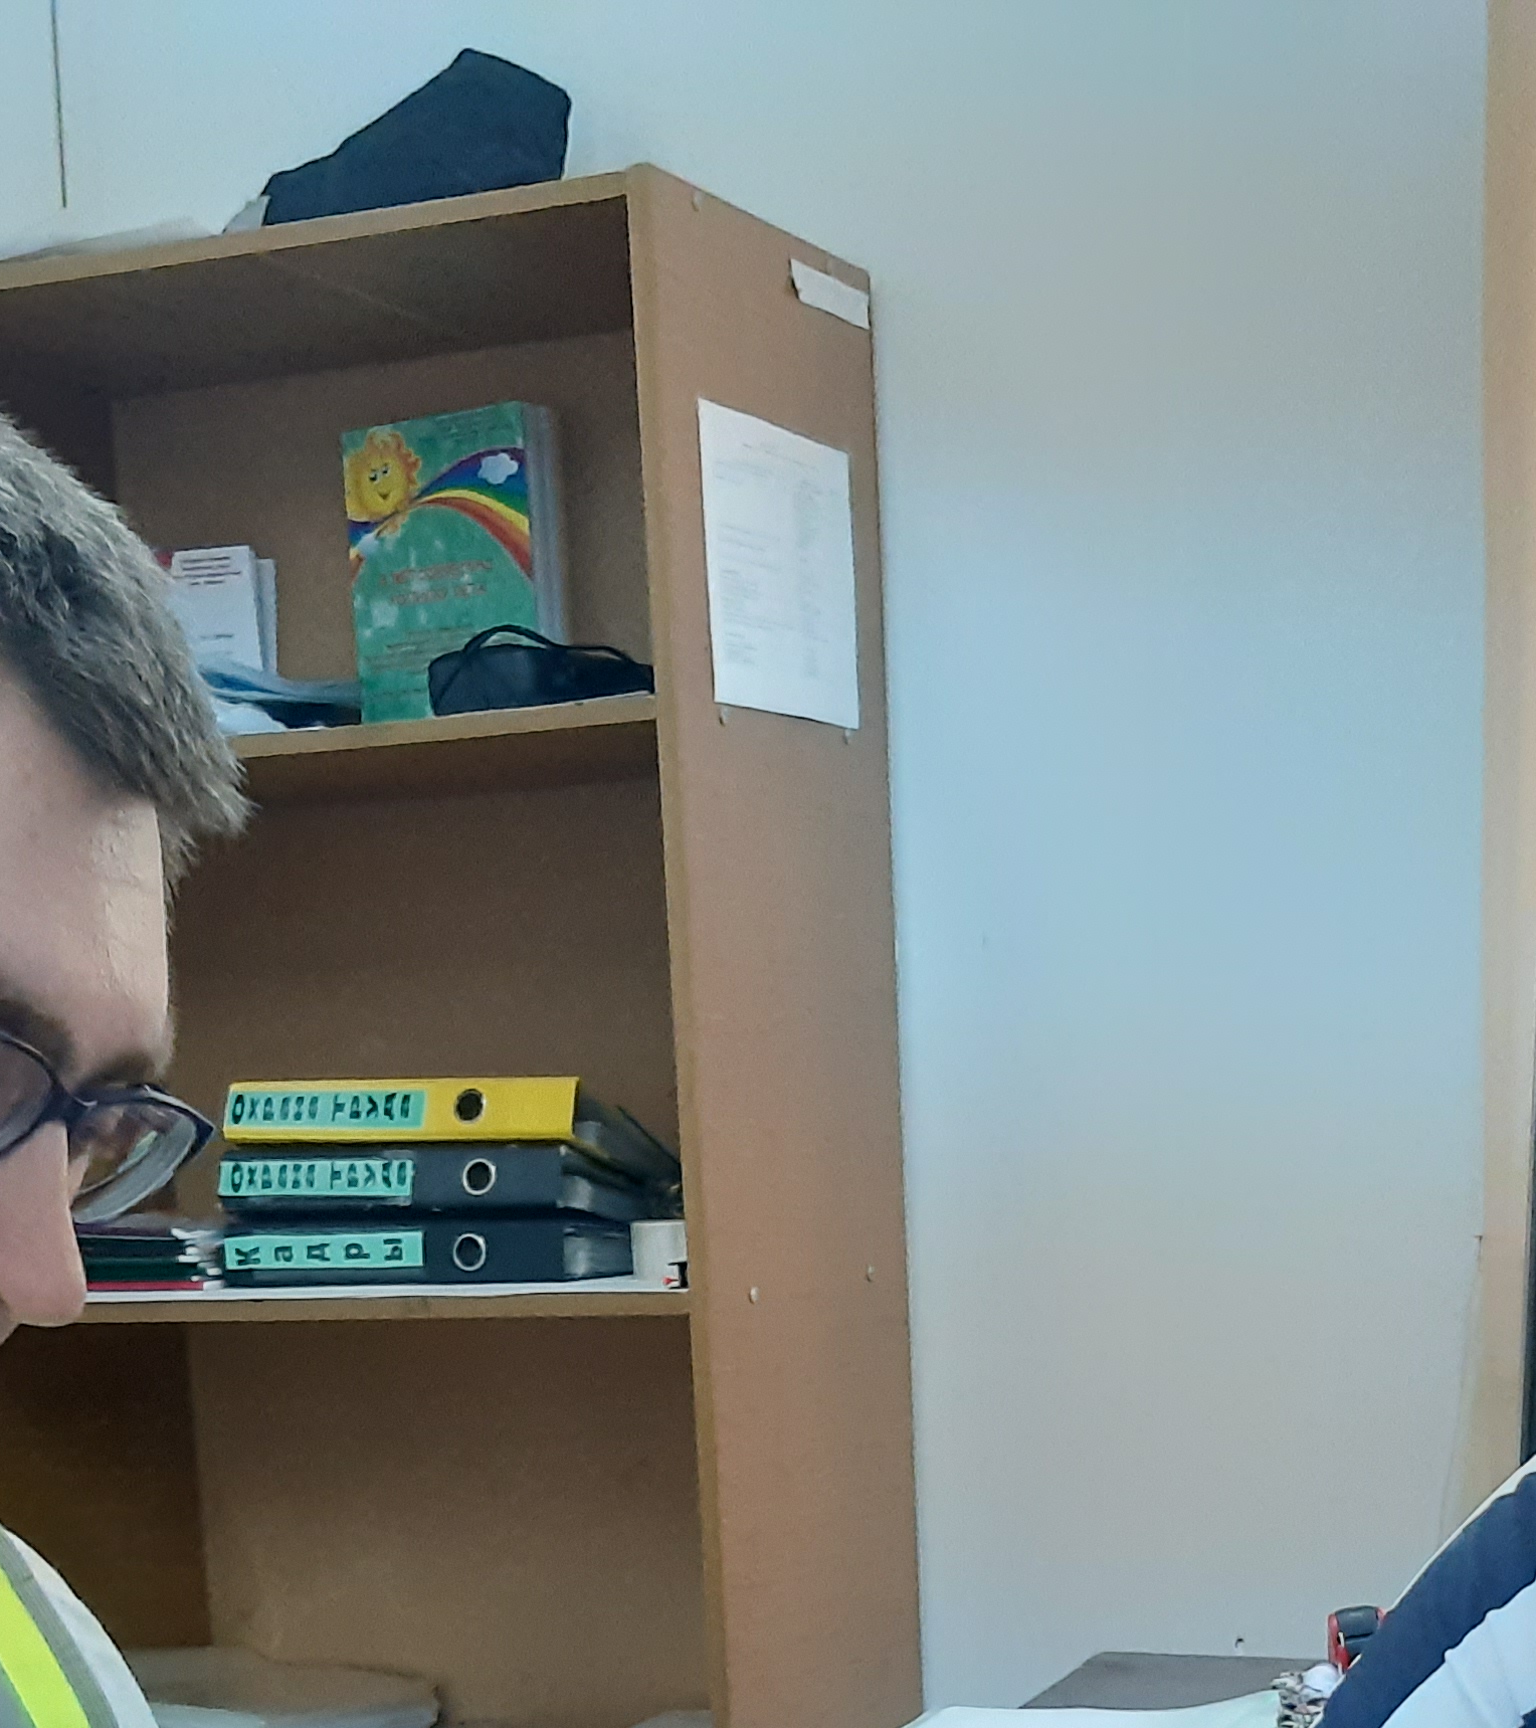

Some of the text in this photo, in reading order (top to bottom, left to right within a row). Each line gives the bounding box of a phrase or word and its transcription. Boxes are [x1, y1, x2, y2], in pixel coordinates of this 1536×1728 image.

[232, 1094, 319, 1124] Охрана
[231, 1164, 315, 1192] Охрана
[235, 1238, 404, 1265] Кадры
